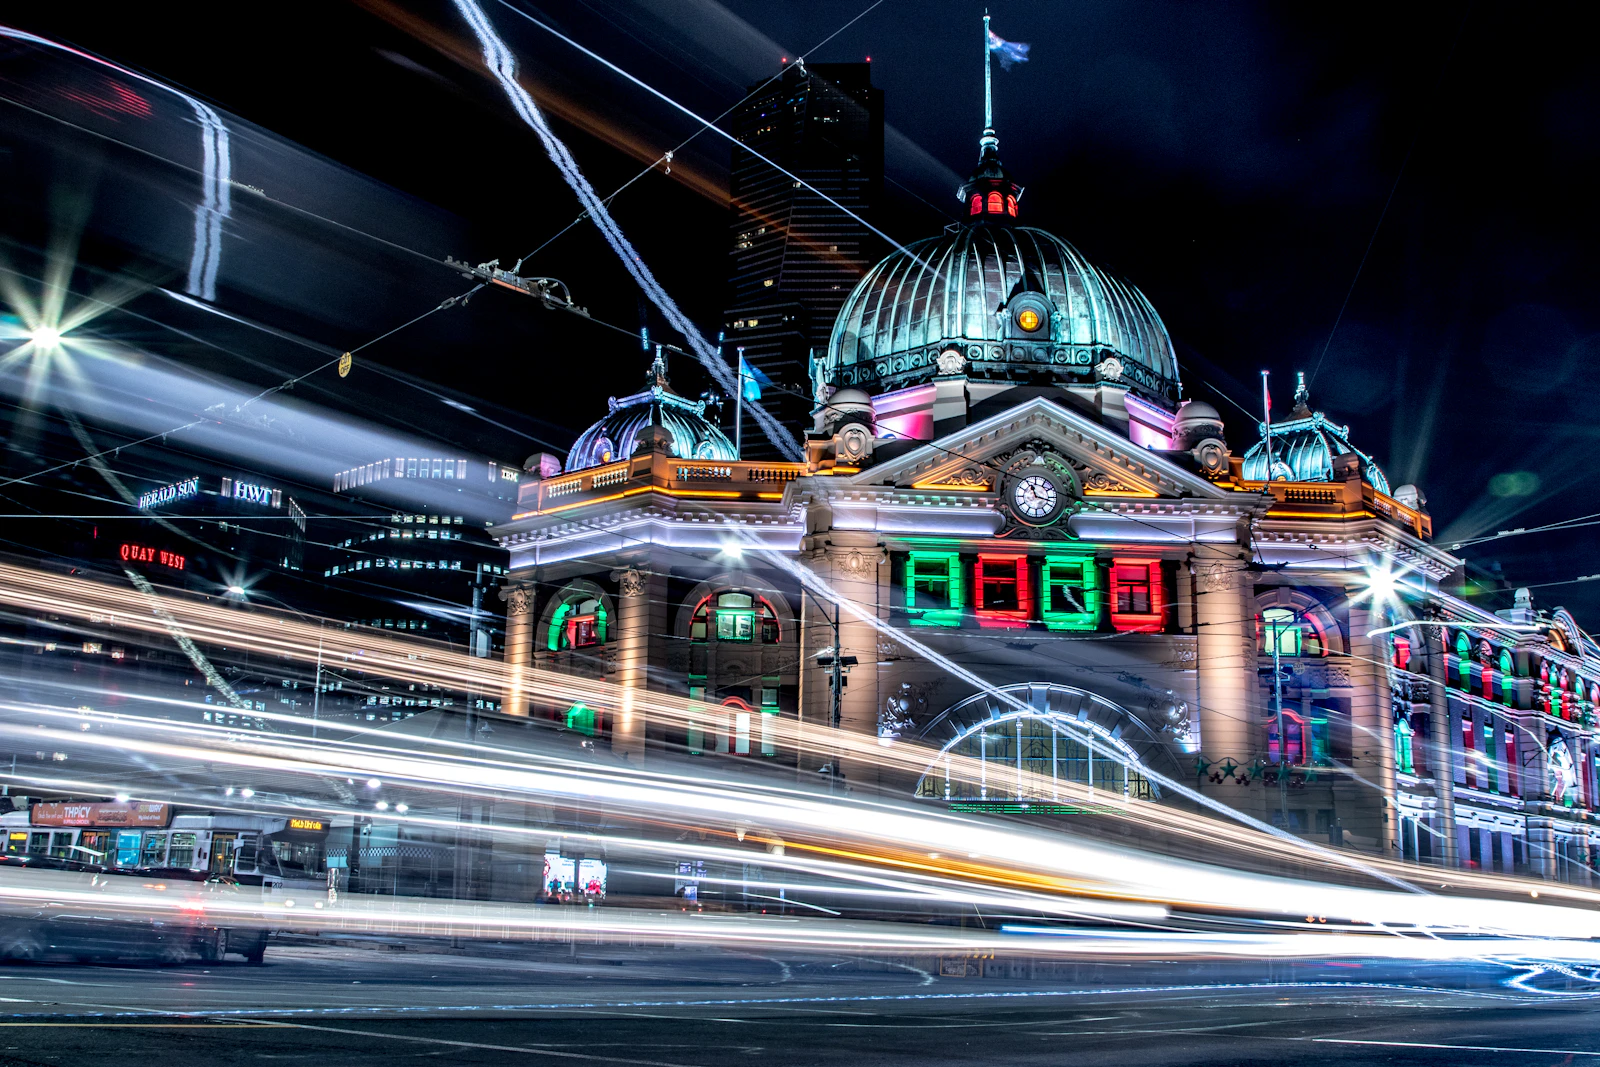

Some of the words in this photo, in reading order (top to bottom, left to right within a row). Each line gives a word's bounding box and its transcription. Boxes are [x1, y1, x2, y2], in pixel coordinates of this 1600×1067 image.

[340, 365, 350, 375] OFF
[501, 469, 518, 482] IBM
[138, 486, 176, 509] HERALD
[178, 479, 198, 497] SUN
[234, 480, 272, 505] HWT
[120, 544, 155, 562] QUAY
[160, 550, 185, 570] WEST
